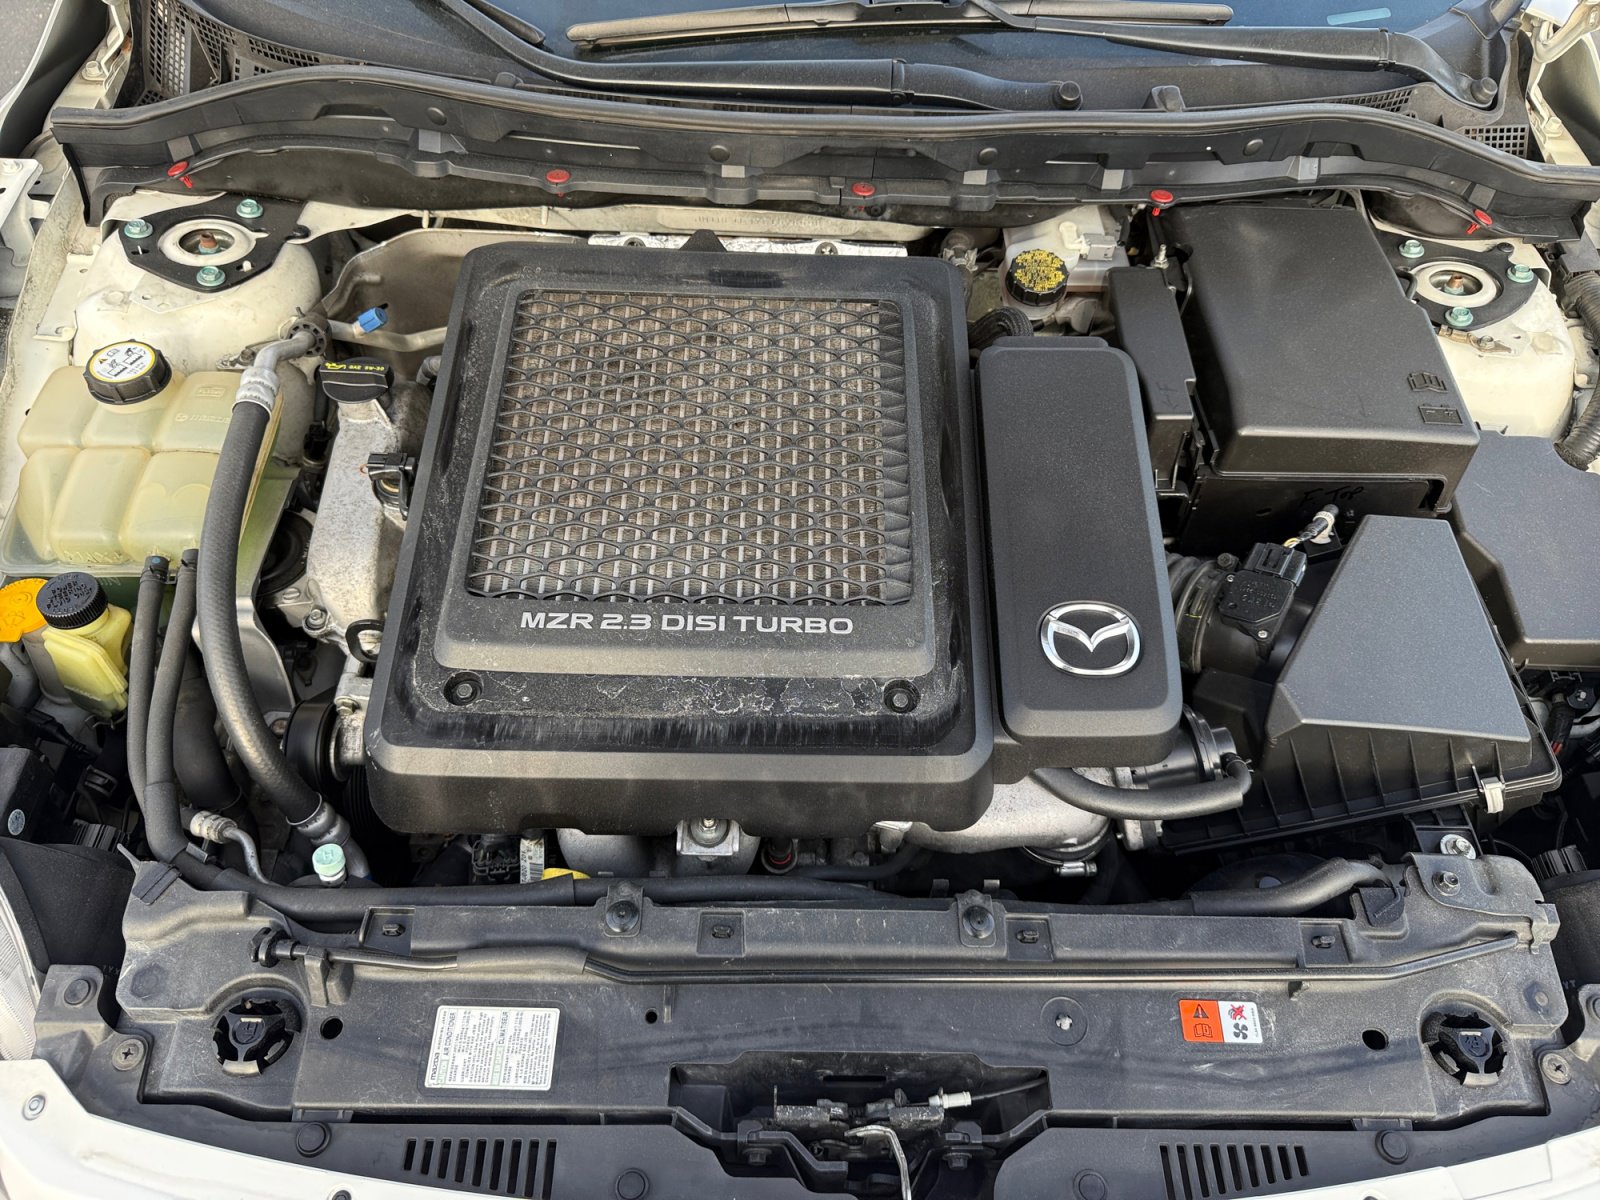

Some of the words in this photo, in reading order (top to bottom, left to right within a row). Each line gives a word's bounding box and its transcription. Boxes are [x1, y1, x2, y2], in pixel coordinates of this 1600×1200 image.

[520, 611, 594, 630] MZR
[599, 613, 653, 631] 2.3
[660, 614, 726, 632] DISI
[732, 615, 854, 635] TURBO
[445, 1013, 456, 1046] CONDITIONER
[498, 1011, 509, 1044] CLIMATISEUR
[431, 1052, 440, 1080] mazda
